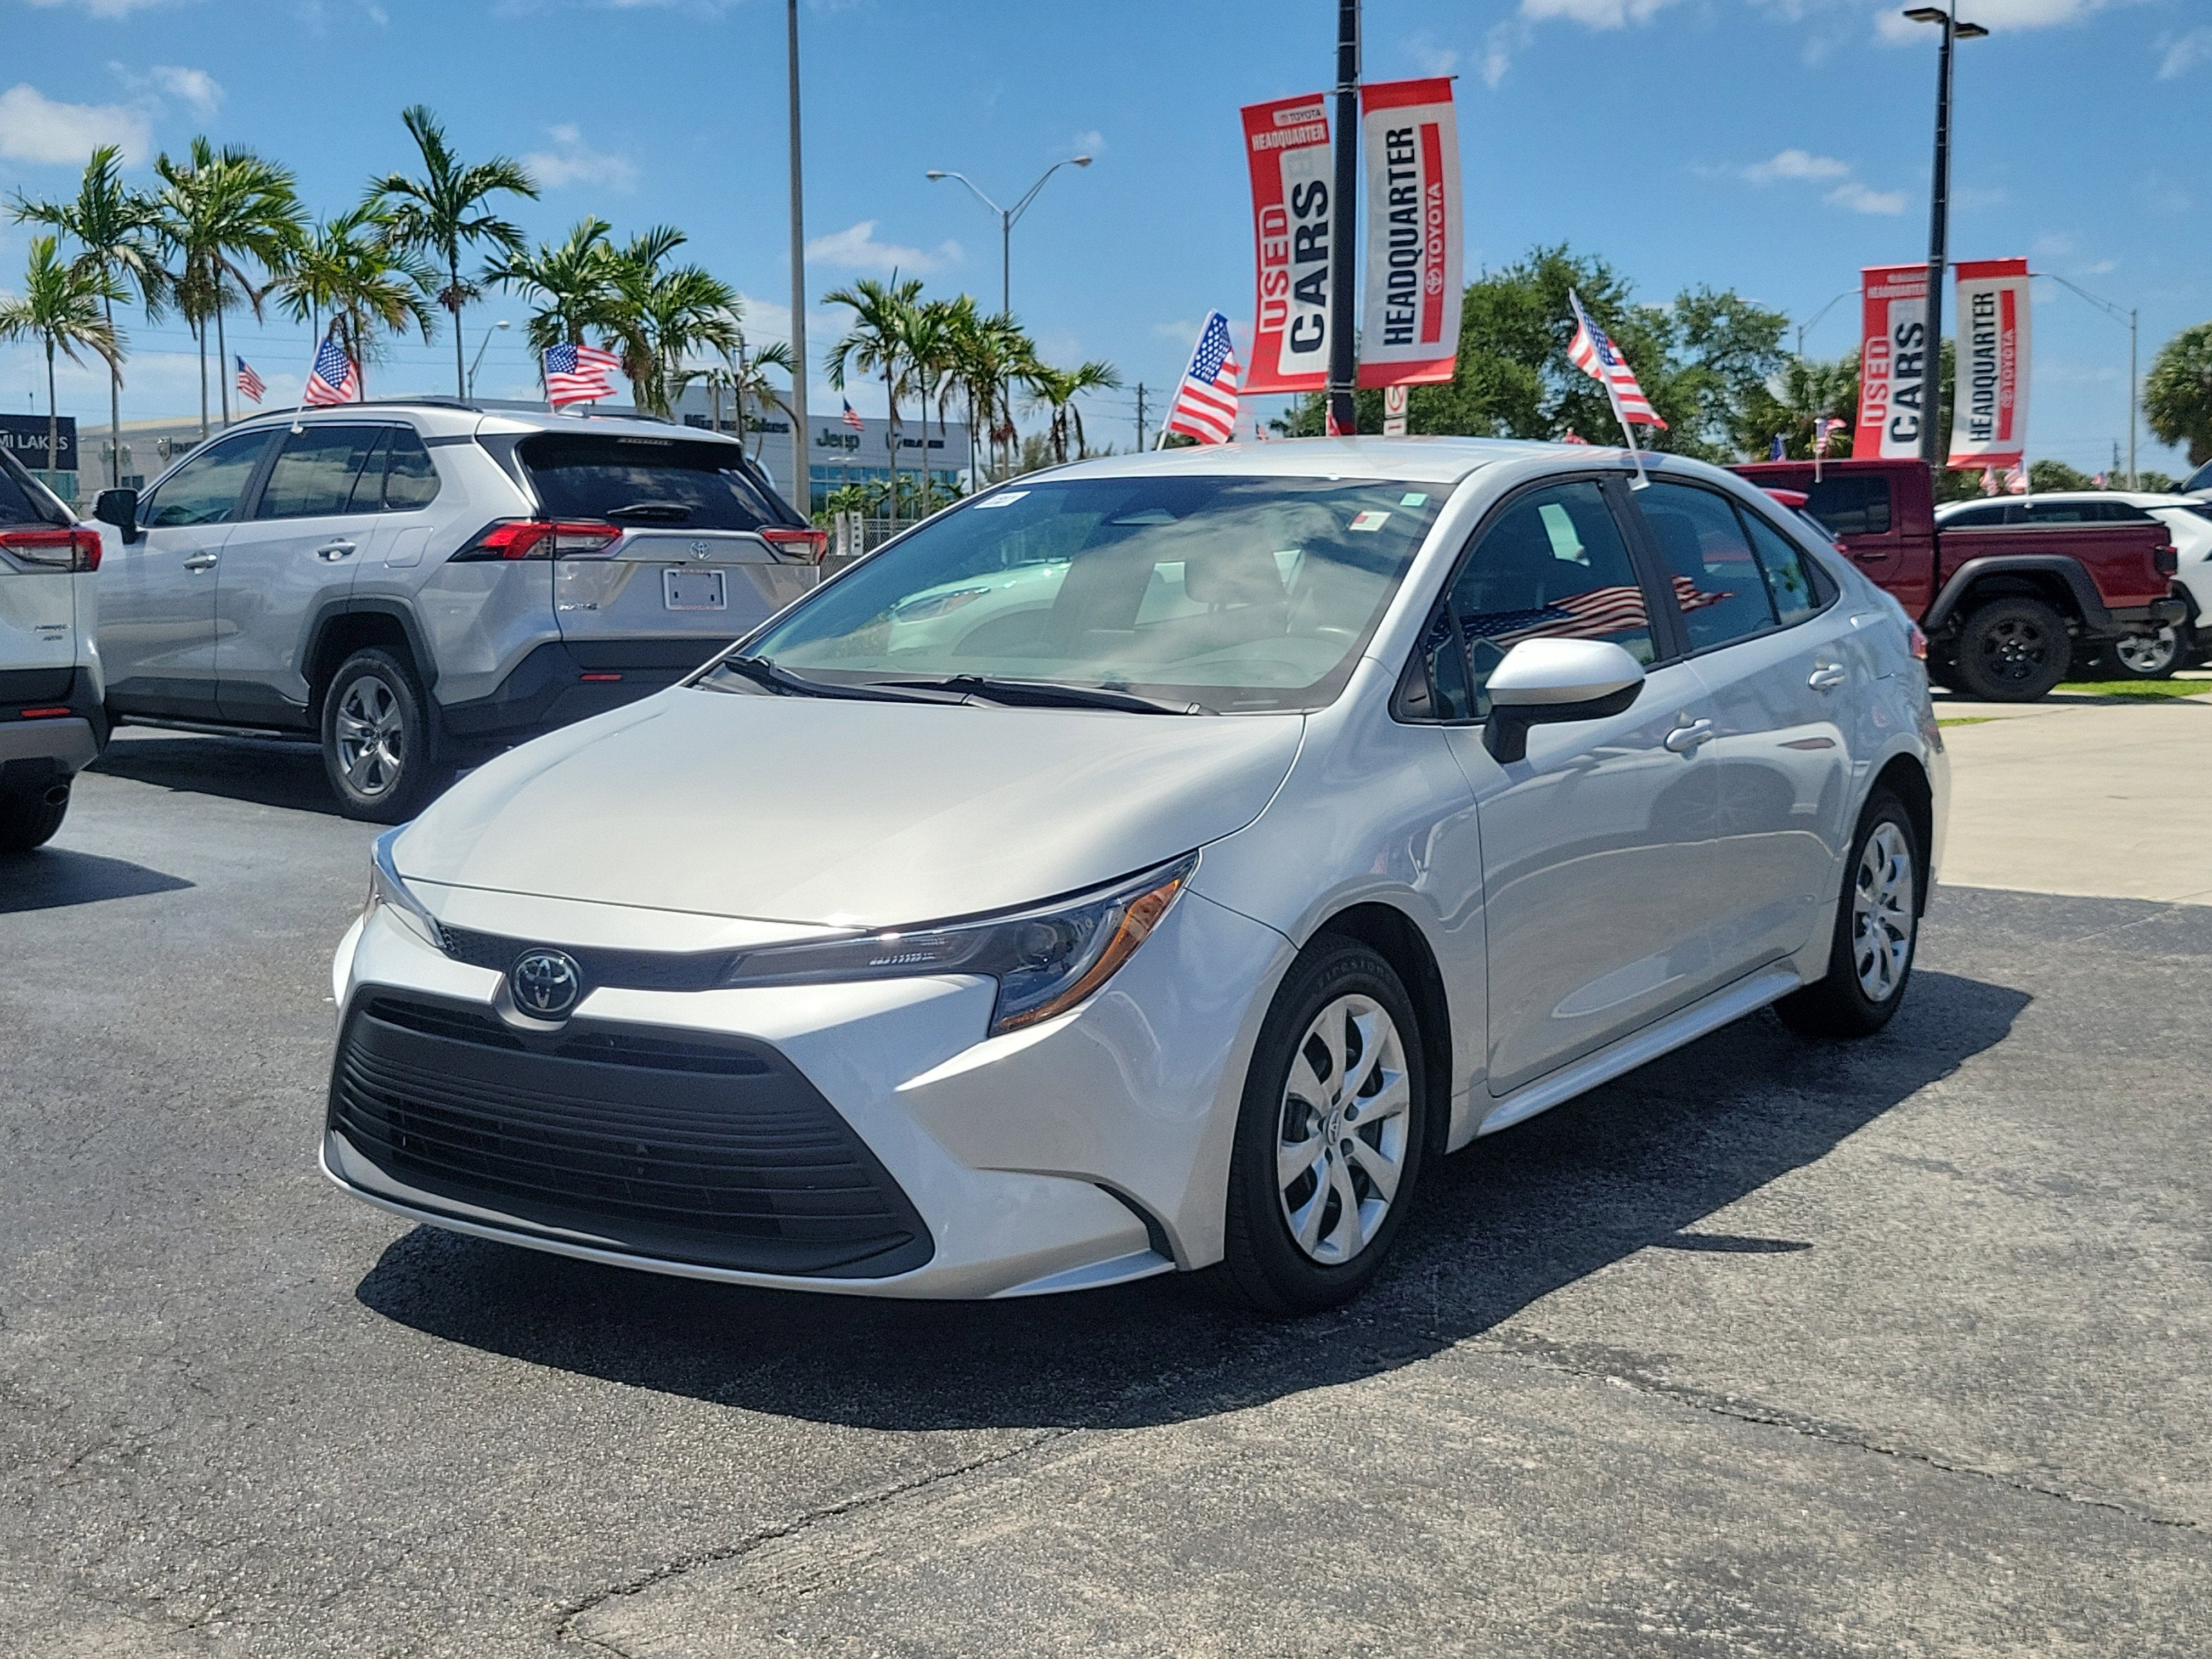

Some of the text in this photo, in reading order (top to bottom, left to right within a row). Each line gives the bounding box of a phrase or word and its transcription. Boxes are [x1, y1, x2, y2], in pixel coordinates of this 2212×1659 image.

[1252, 123, 1325, 151] HEADQUARTER
[1289, 109, 1321, 122] TOYOTA
[1263, 208, 1289, 328] USED
[1290, 180, 1328, 353] CARS
[1383, 127, 1423, 346] HEADQUARTER
[1427, 182, 1442, 268] TOYOTA
[1865, 340, 1890, 422] USED
[1891, 323, 1923, 442] CARS
[1970, 292, 1998, 442] HEADQUARTER
[18, 435, 69, 450] LAKS
